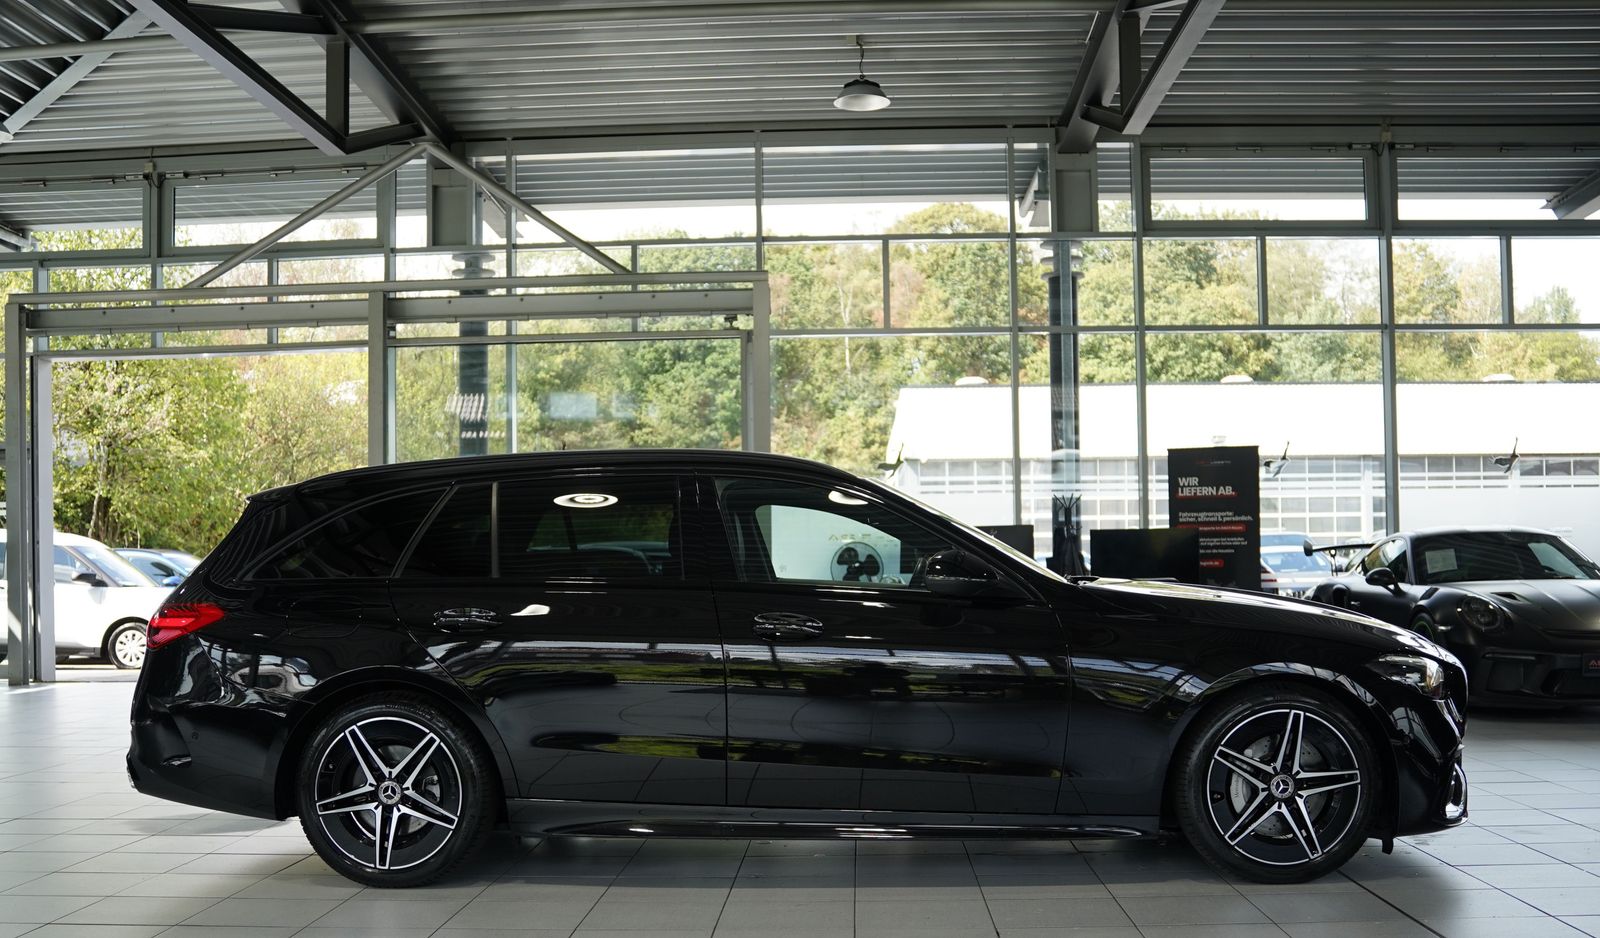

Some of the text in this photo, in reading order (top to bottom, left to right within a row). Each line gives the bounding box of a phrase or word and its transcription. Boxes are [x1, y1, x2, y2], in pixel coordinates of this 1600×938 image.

[1178, 477, 1199, 486] WIR
[1178, 486, 1235, 496] LIEFERN AB.
